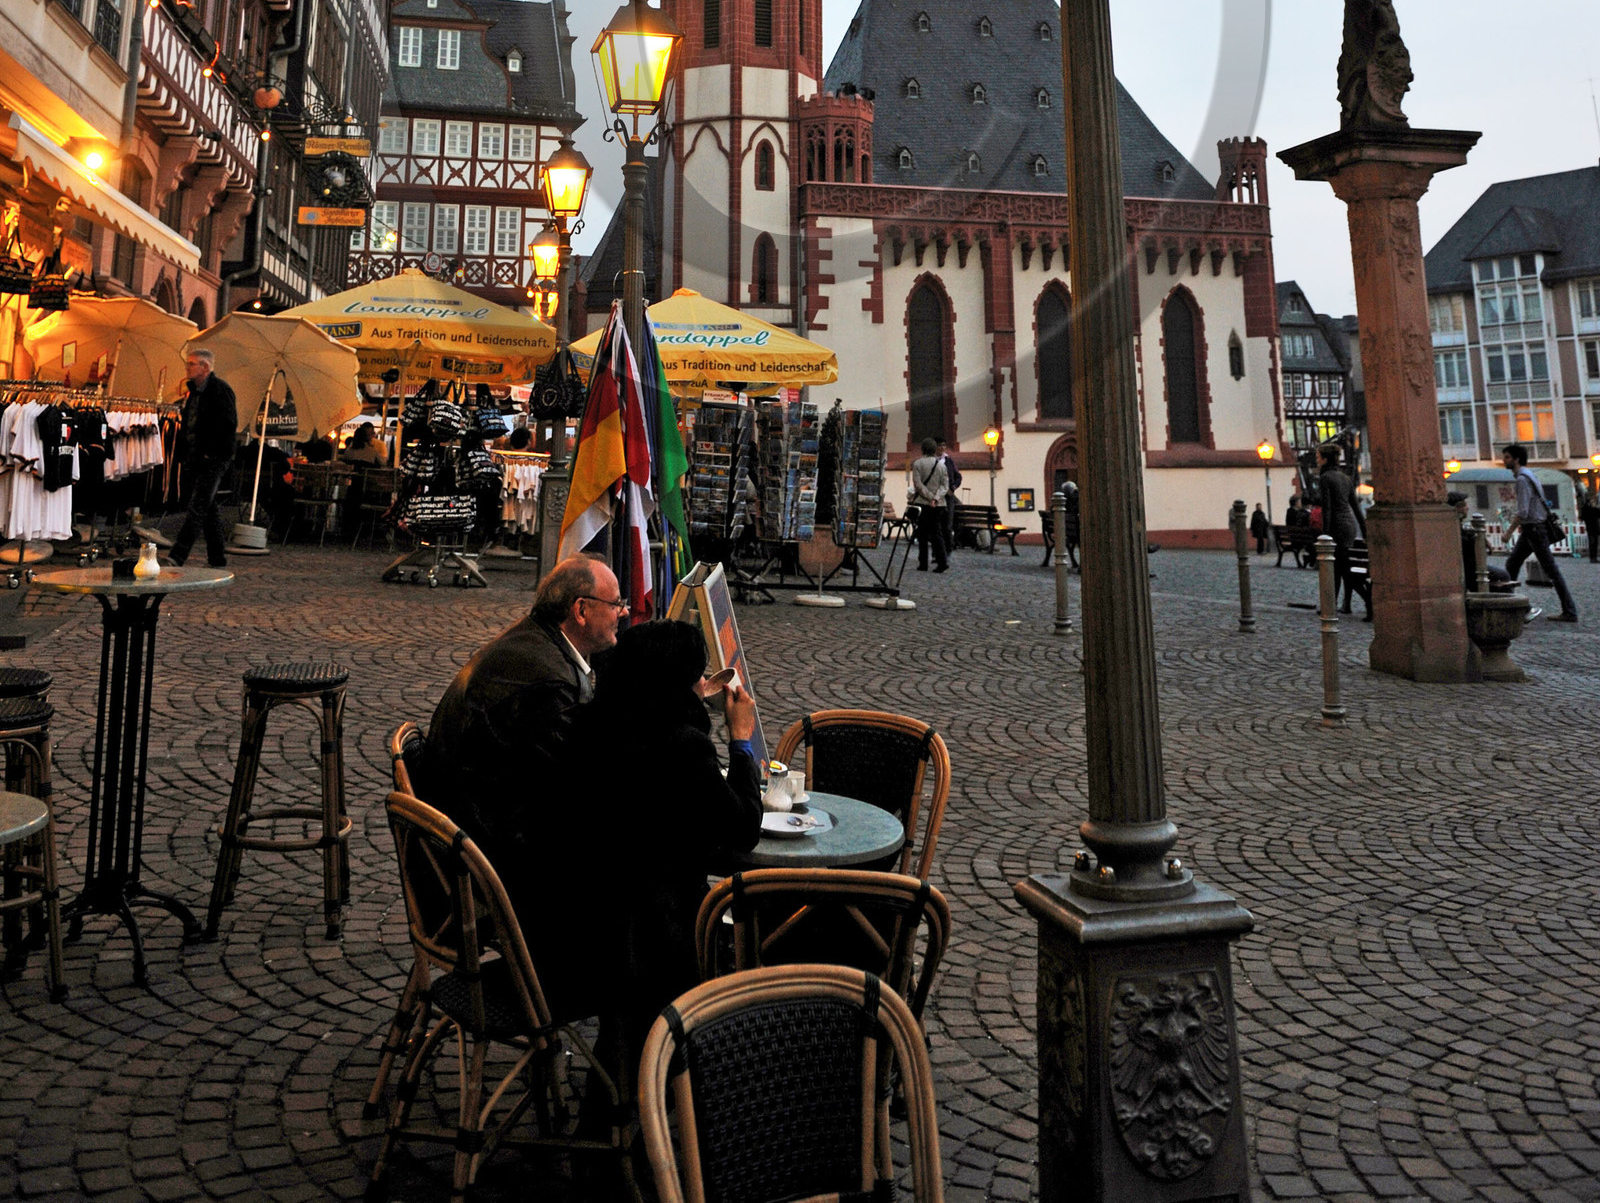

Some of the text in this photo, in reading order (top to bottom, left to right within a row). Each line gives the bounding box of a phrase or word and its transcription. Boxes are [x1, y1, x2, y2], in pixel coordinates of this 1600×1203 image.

[343, 301, 490, 319] Landappel
[371, 328, 551, 348] Aus Tradition und Leidenschaft.
[655, 332, 769, 347] ndappel
[682, 359, 731, 371] Tradition
[735, 361, 756, 372] und
